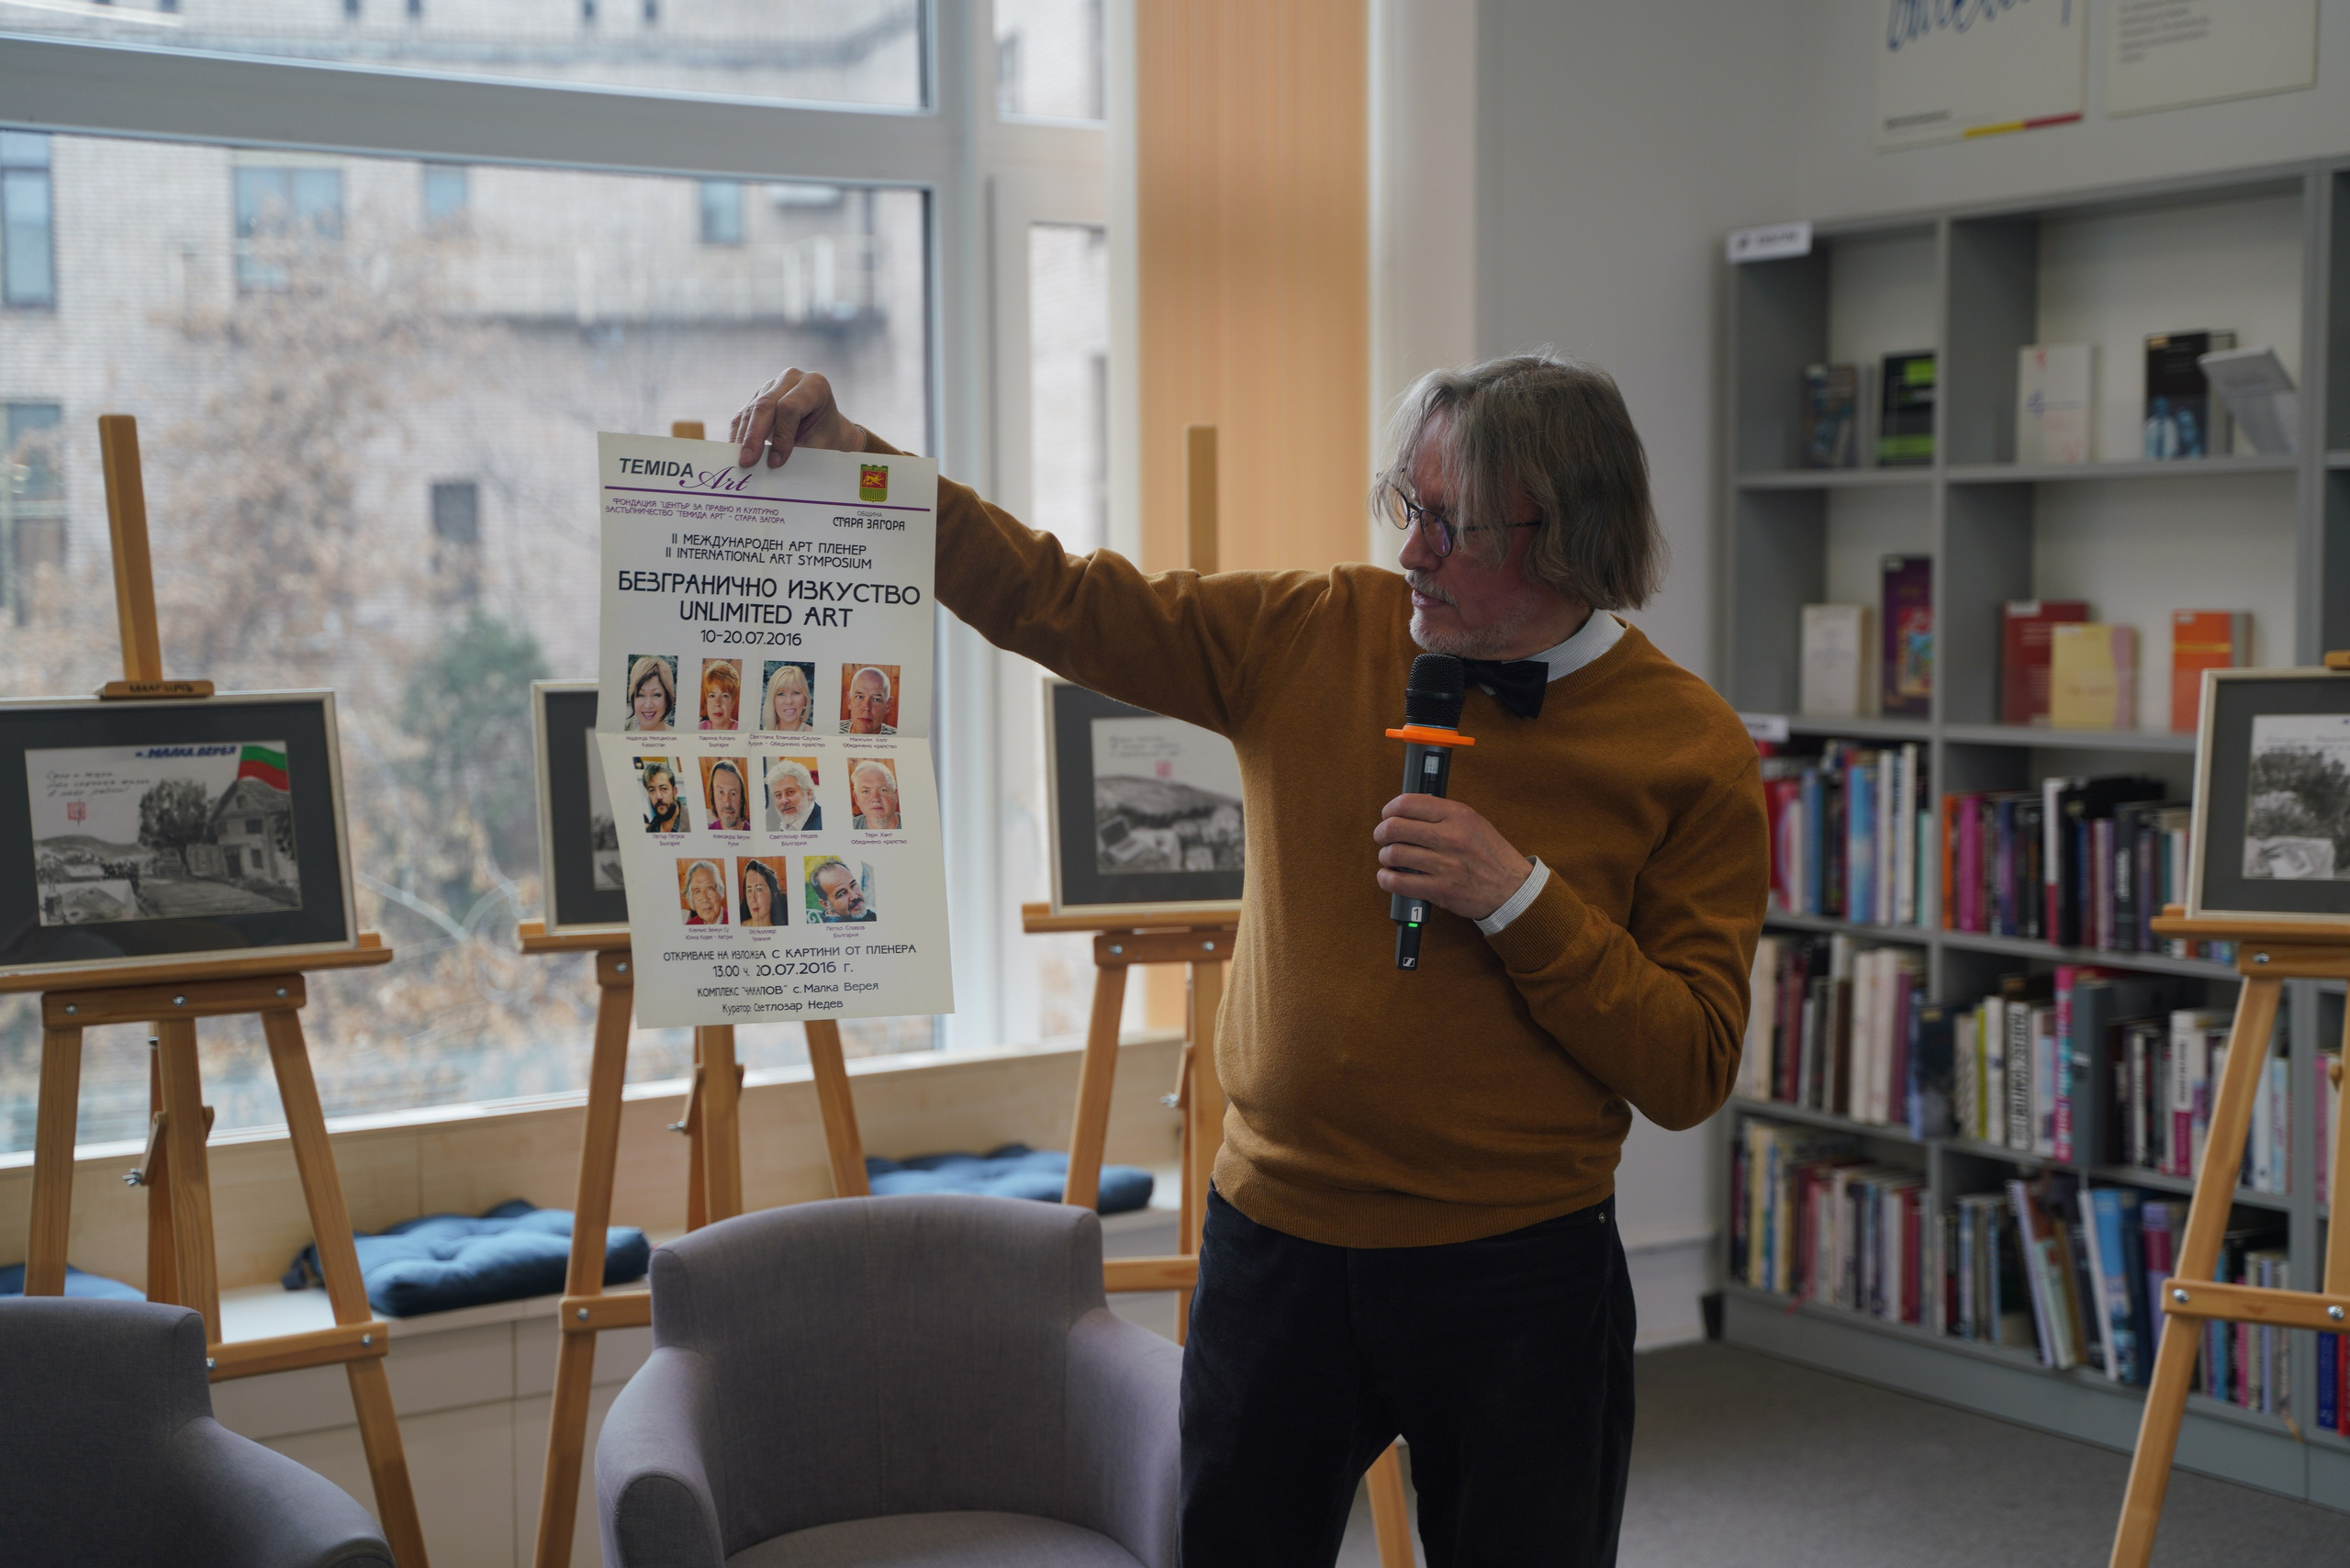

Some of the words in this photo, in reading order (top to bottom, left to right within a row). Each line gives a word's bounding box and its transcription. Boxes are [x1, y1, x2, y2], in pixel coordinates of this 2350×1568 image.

[619, 457, 693, 478] TEMIDA
[679, 465, 752, 492] Art
[605, 506, 674, 517] ЗАСТЪПНИЧЕСТВО
[734, 515, 757, 523] СТАРА
[759, 516, 786, 525] ЗАГОРА
[612, 498, 657, 508] ФОНДАЦИЯ
[705, 504, 734, 513] ПРАВНО
[744, 507, 779, 517] КУЛТУРНО
[833, 516, 864, 530] СТАРА
[866, 518, 906, 532] ЗАГОРА
[683, 534, 784, 553] МЕЖДУНАРОДЕН
[789, 540, 813, 552] АРТ
[818, 543, 867, 556] ПЛЕНЕР
[677, 547, 766, 565] INTERNATIONAL
[769, 554, 793, 566] ART
[798, 554, 873, 570] SYMPOSIUM
[618, 570, 778, 599] БЕЗГРАНИЧНО
[788, 579, 922, 606] ИЗКУСТВО
[679, 600, 792, 625] UNLIMITED
[803, 607, 855, 628] ART
[700, 629, 802, 647] 10-20.07.2016
[663, 950, 715, 962] ОТКРИВАНЕ
[718, 951, 729, 960] НА
[732, 949, 767, 960] ИЗЛОЖБА
[772, 949, 780, 959] С
[785, 946, 840, 959] КАРТИНИ
[845, 946, 861, 956] ОТ
[866, 944, 917, 956] ПЛЕНЕРА
[712, 965, 740, 978] 13.00
[755, 961, 836, 978] 20.07.2016
[844, 962, 855, 973] г.
[697, 986, 740, 998] КОМПЛЕКС
[844, 981, 879, 993] Верея
[753, 1001, 803, 1014] Светлозар
[808, 999, 844, 1010] Недев
